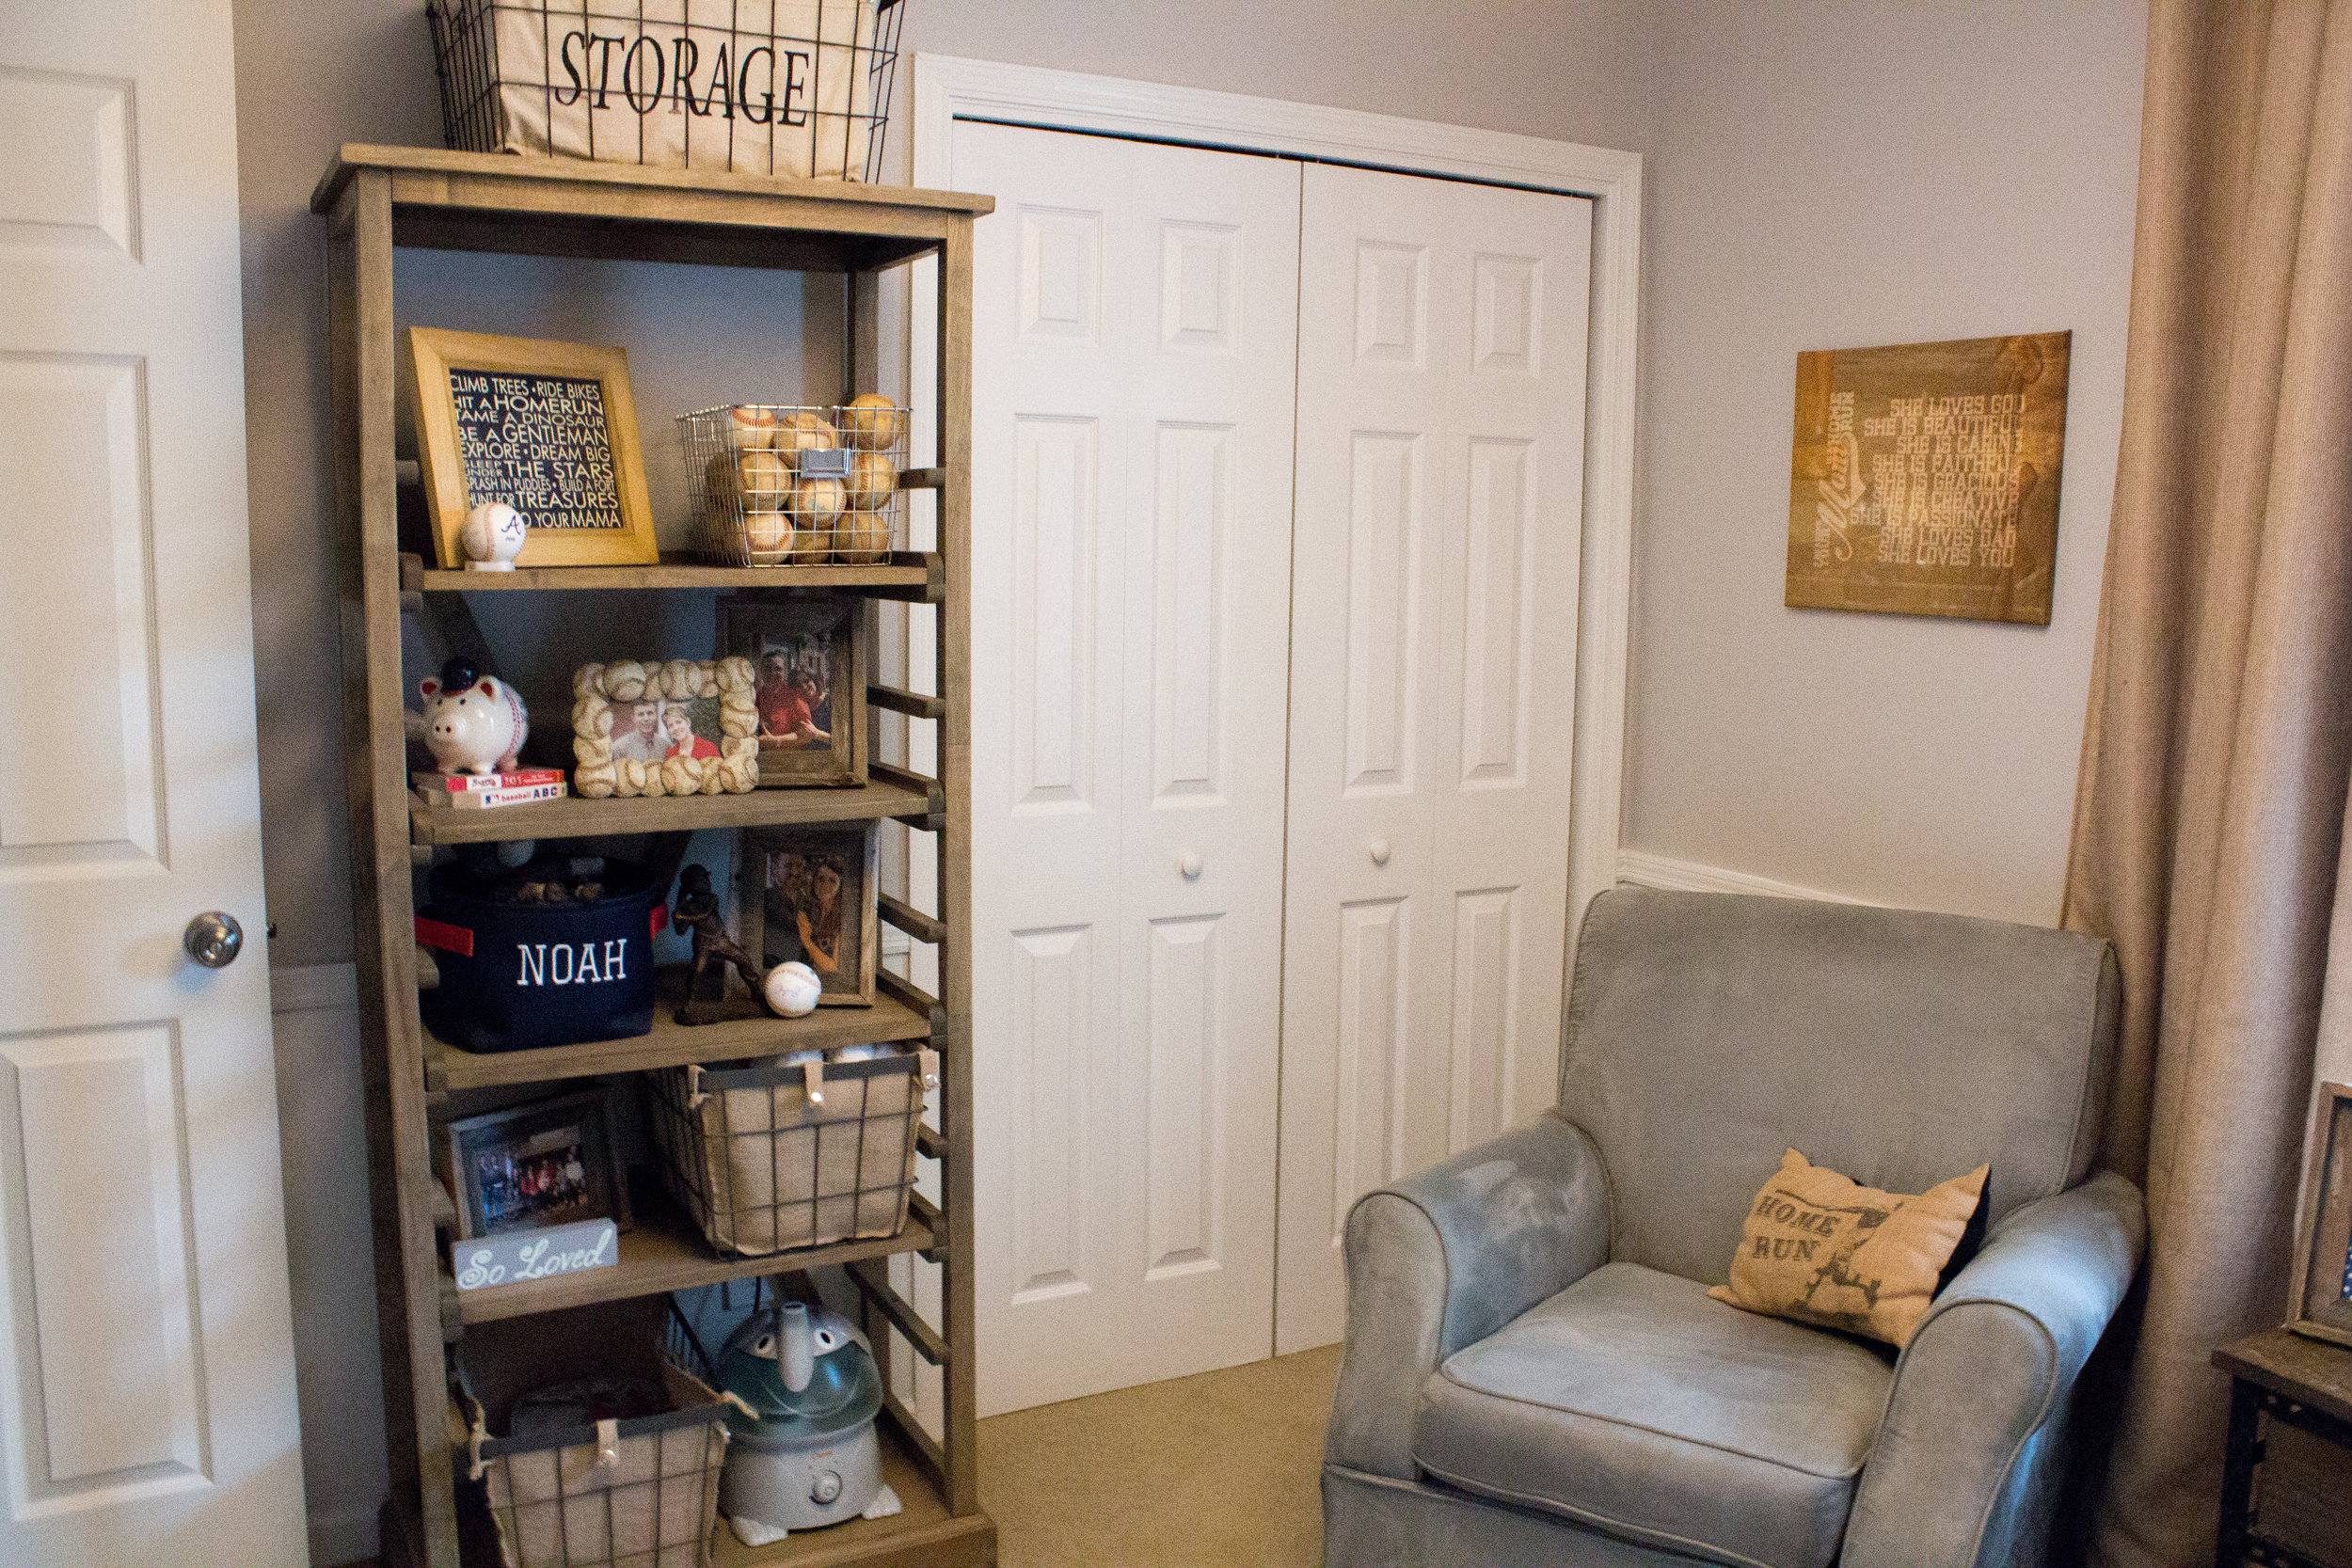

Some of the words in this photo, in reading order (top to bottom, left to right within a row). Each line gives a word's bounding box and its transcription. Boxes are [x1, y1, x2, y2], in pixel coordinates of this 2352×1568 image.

[554, 30, 809, 127] STORAGE
[450, 374, 489, 393] CLIMB
[491, 377, 530, 396] TREES
[536, 381, 564, 398] RIDE
[566, 383, 600, 401] BIKES
[480, 397, 493, 410] A
[494, 394, 604, 416] HOMERUN
[1890, 398, 1924, 417] SHE
[1929, 395, 1985, 416] LOVES
[504, 412, 517, 424] A
[521, 412, 604, 428] DINOSAUR
[1864, 417, 1896, 436] SHE
[1901, 417, 1917, 436] IS
[485, 428, 501, 443] A
[502, 423, 609, 446] GENTLEMAN
[530, 444, 582, 461] DREAM
[585, 445, 611, 463] BIG
[1897, 436, 1930, 454] SHE
[1935, 436, 1951, 453] IS
[503, 459, 546, 479] THE
[552, 462, 613, 480] STARS
[1872, 454, 1904, 472] SHE
[1910, 454, 1926, 472] IS
[1931, 452, 2014, 472] FAITHFU
[467, 476, 499, 491] PLASH
[500, 478, 512, 491] IN
[514, 477, 552, 492] PUDDLES
[559, 479, 583, 492] BUILD
[585, 480, 593, 491] A
[594, 480, 615, 492] FORT
[1874, 473, 1907, 491] SHE
[1912, 473, 1927, 491] IS
[1933, 472, 2020, 492] GRACIOUS
[496, 492, 516, 507] FOR
[516, 490, 618, 509] TREASURES
[1872, 491, 1905, 509] SHE
[1911, 491, 1926, 509] IS
[1931, 490, 2019, 510] CREATIVE
[533, 512, 570, 528] YOUR
[571, 509, 622, 528] MAMA
[1850, 509, 1882, 527] SHE
[1886, 509, 1903, 527] IS
[1908, 509, 2017, 529] PASSIONATE
[1881, 527, 1914, 546] SHE
[1919, 528, 1973, 546] LOVES
[1980, 529, 2017, 547] DAD
[1877, 546, 1911, 564] SHE
[1916, 546, 1972, 566] LOVES
[1978, 547, 2014, 568] YOU
[516, 939, 628, 986] NOAH
[1755, 1196, 1840, 1238] HOME
[1752, 1236, 1821, 1261] RUN
[457, 1249, 504, 1290] So
[514, 1228, 612, 1279] Loved
